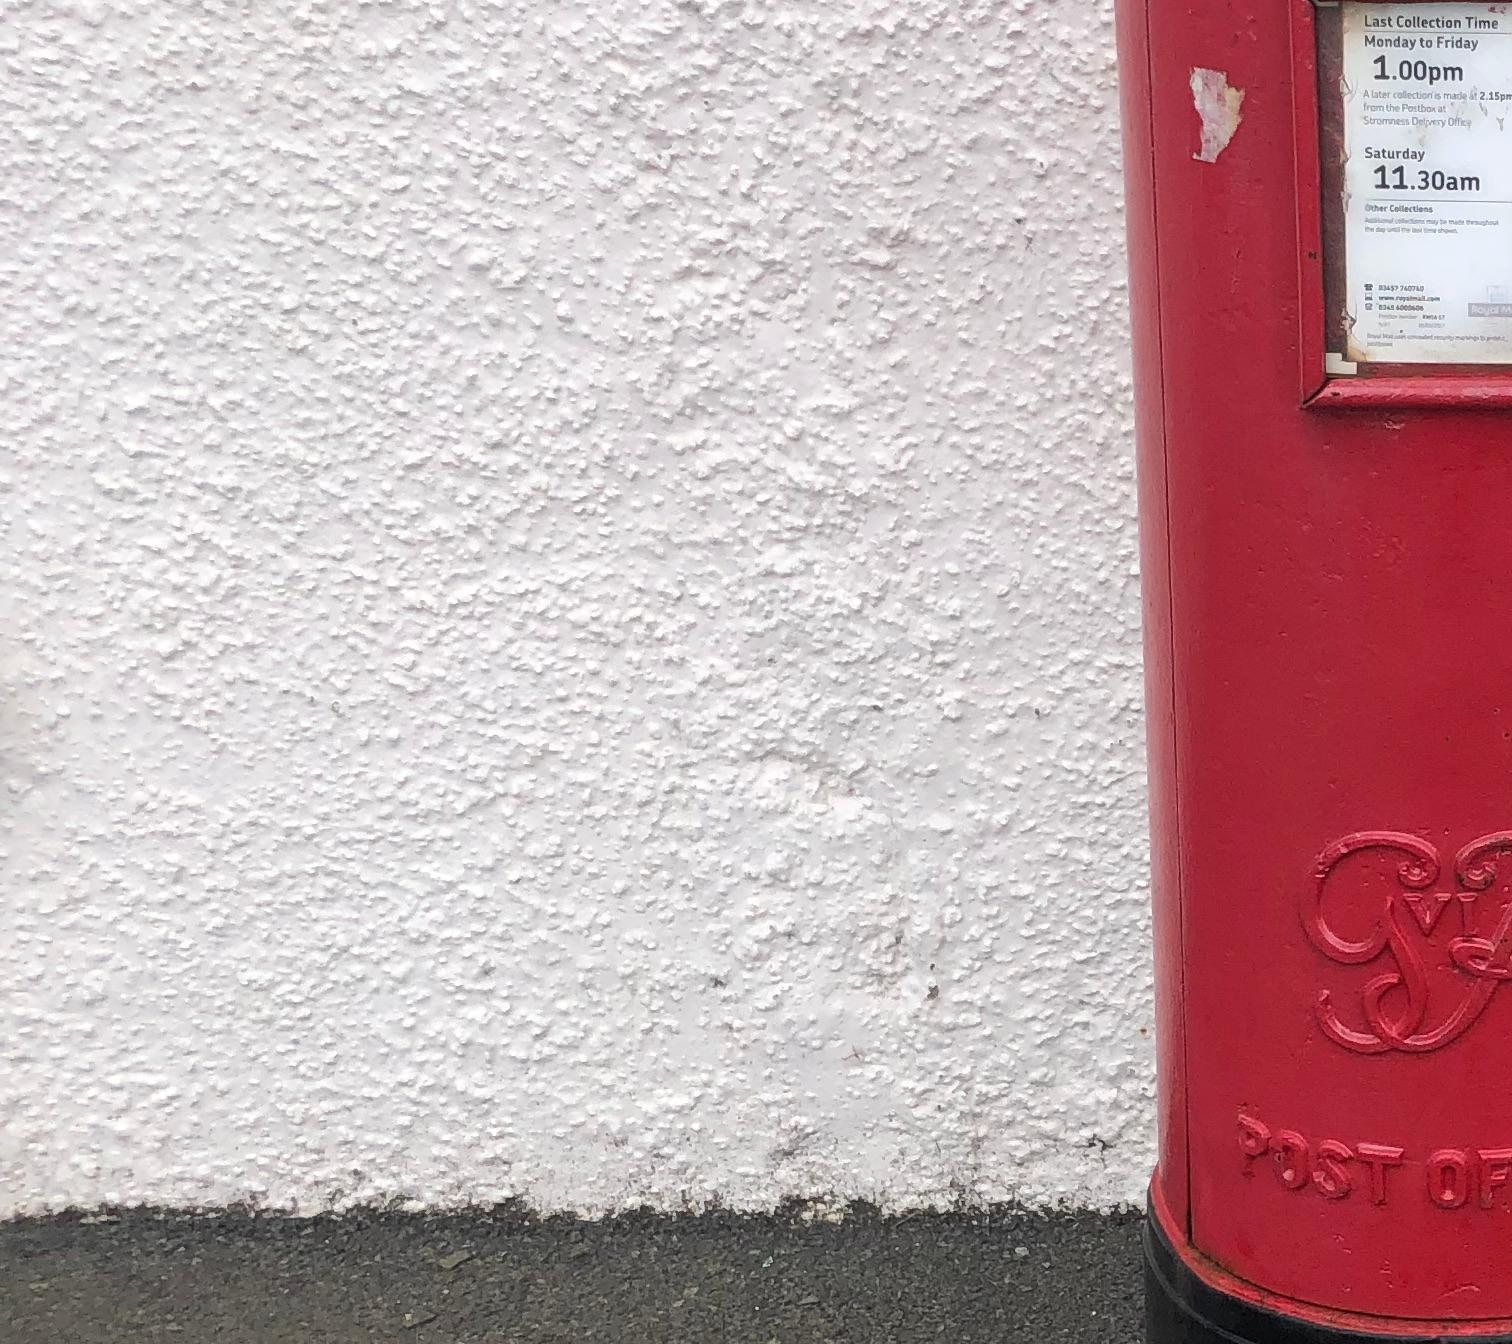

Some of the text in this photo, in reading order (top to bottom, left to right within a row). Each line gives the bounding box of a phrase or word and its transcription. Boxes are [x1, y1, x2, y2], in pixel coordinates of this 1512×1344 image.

[1364, 15, 1499, 30] Last Collection Time
[1364, 35, 1479, 51] Monday to Friday
[1373, 54, 1463, 85] 1.00pm
[1363, 90, 1370, 99] A
[1371, 90, 1390, 99] later
[1393, 90, 1433, 100] collection
[1434, 91, 1441, 100] is
[1443, 91, 1468, 101] made
[1363, 103, 1446, 113] from the Postbox at
[1363, 116, 1410, 126] Stromness
[1448, 117, 1472, 128] Office
[1364, 146, 1425, 162] Saturday
[1373, 164, 1480, 191] 11.30am
[1364, 203, 1434, 213] Other Collections
[1236, 1112, 1404, 1207] POST
